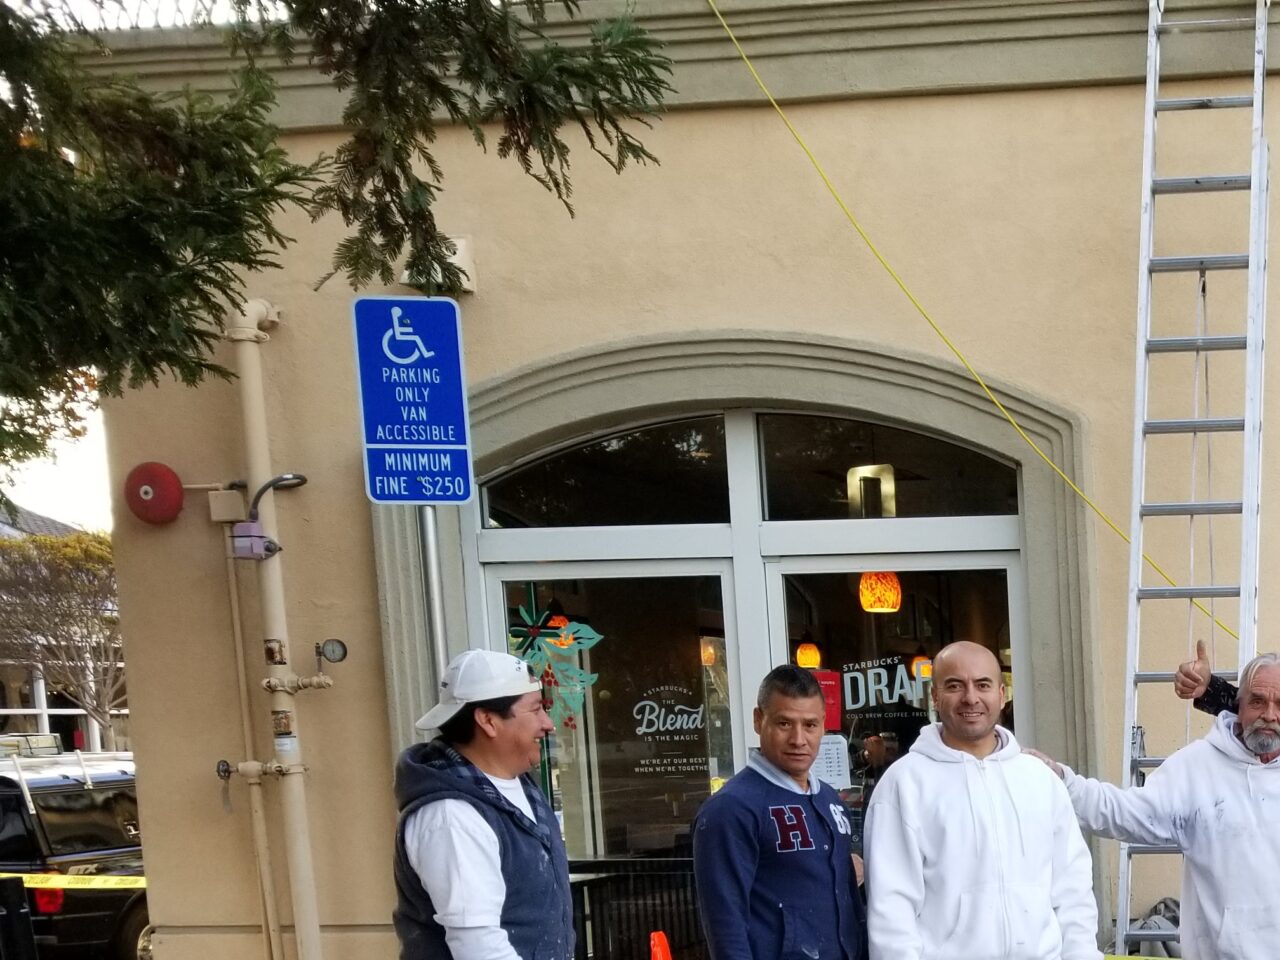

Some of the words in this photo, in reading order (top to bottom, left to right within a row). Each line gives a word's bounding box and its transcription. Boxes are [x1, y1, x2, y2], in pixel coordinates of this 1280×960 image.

[382, 368, 440, 384] PARKING
[395, 387, 430, 402] ONLY
[401, 406, 427, 421] VAN
[376, 425, 456, 441] ACCESSIBLE
[385, 453, 451, 472] MINIMUM
[375, 476, 409, 495] FINE
[422, 476, 464, 496] $250
[841, 656, 900, 672] STARBUCKS
[647, 685, 689, 695] STARBUCKS
[843, 660, 933, 710] DRAF
[633, 700, 704, 735] Blend
[769, 805, 815, 852] H
